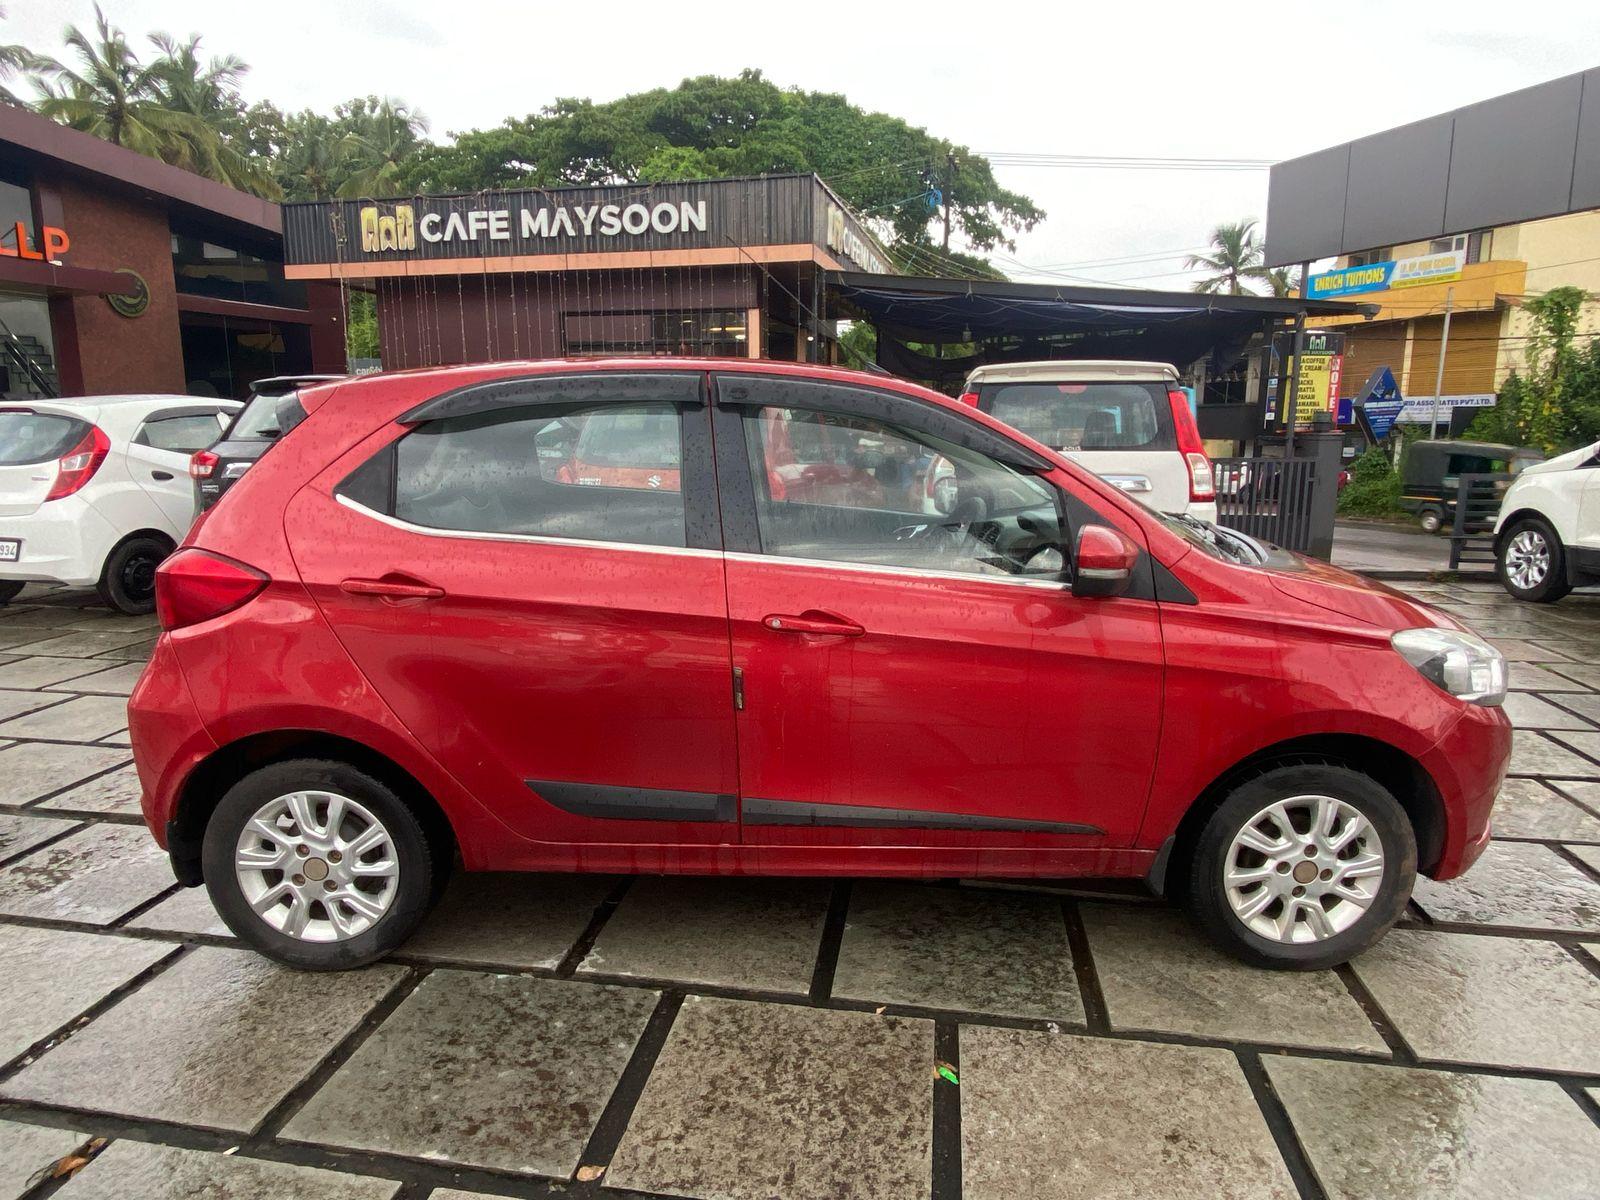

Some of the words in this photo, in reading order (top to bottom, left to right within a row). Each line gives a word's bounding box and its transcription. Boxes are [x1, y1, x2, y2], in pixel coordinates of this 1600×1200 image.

[420, 210, 509, 242] CAFE
[520, 201, 707, 239] MAYSOON
[1314, 273, 1344, 292] ENRICH
[1345, 266, 1386, 288] TUITIONS
[1416, 399, 1459, 407] ASSOIATES
